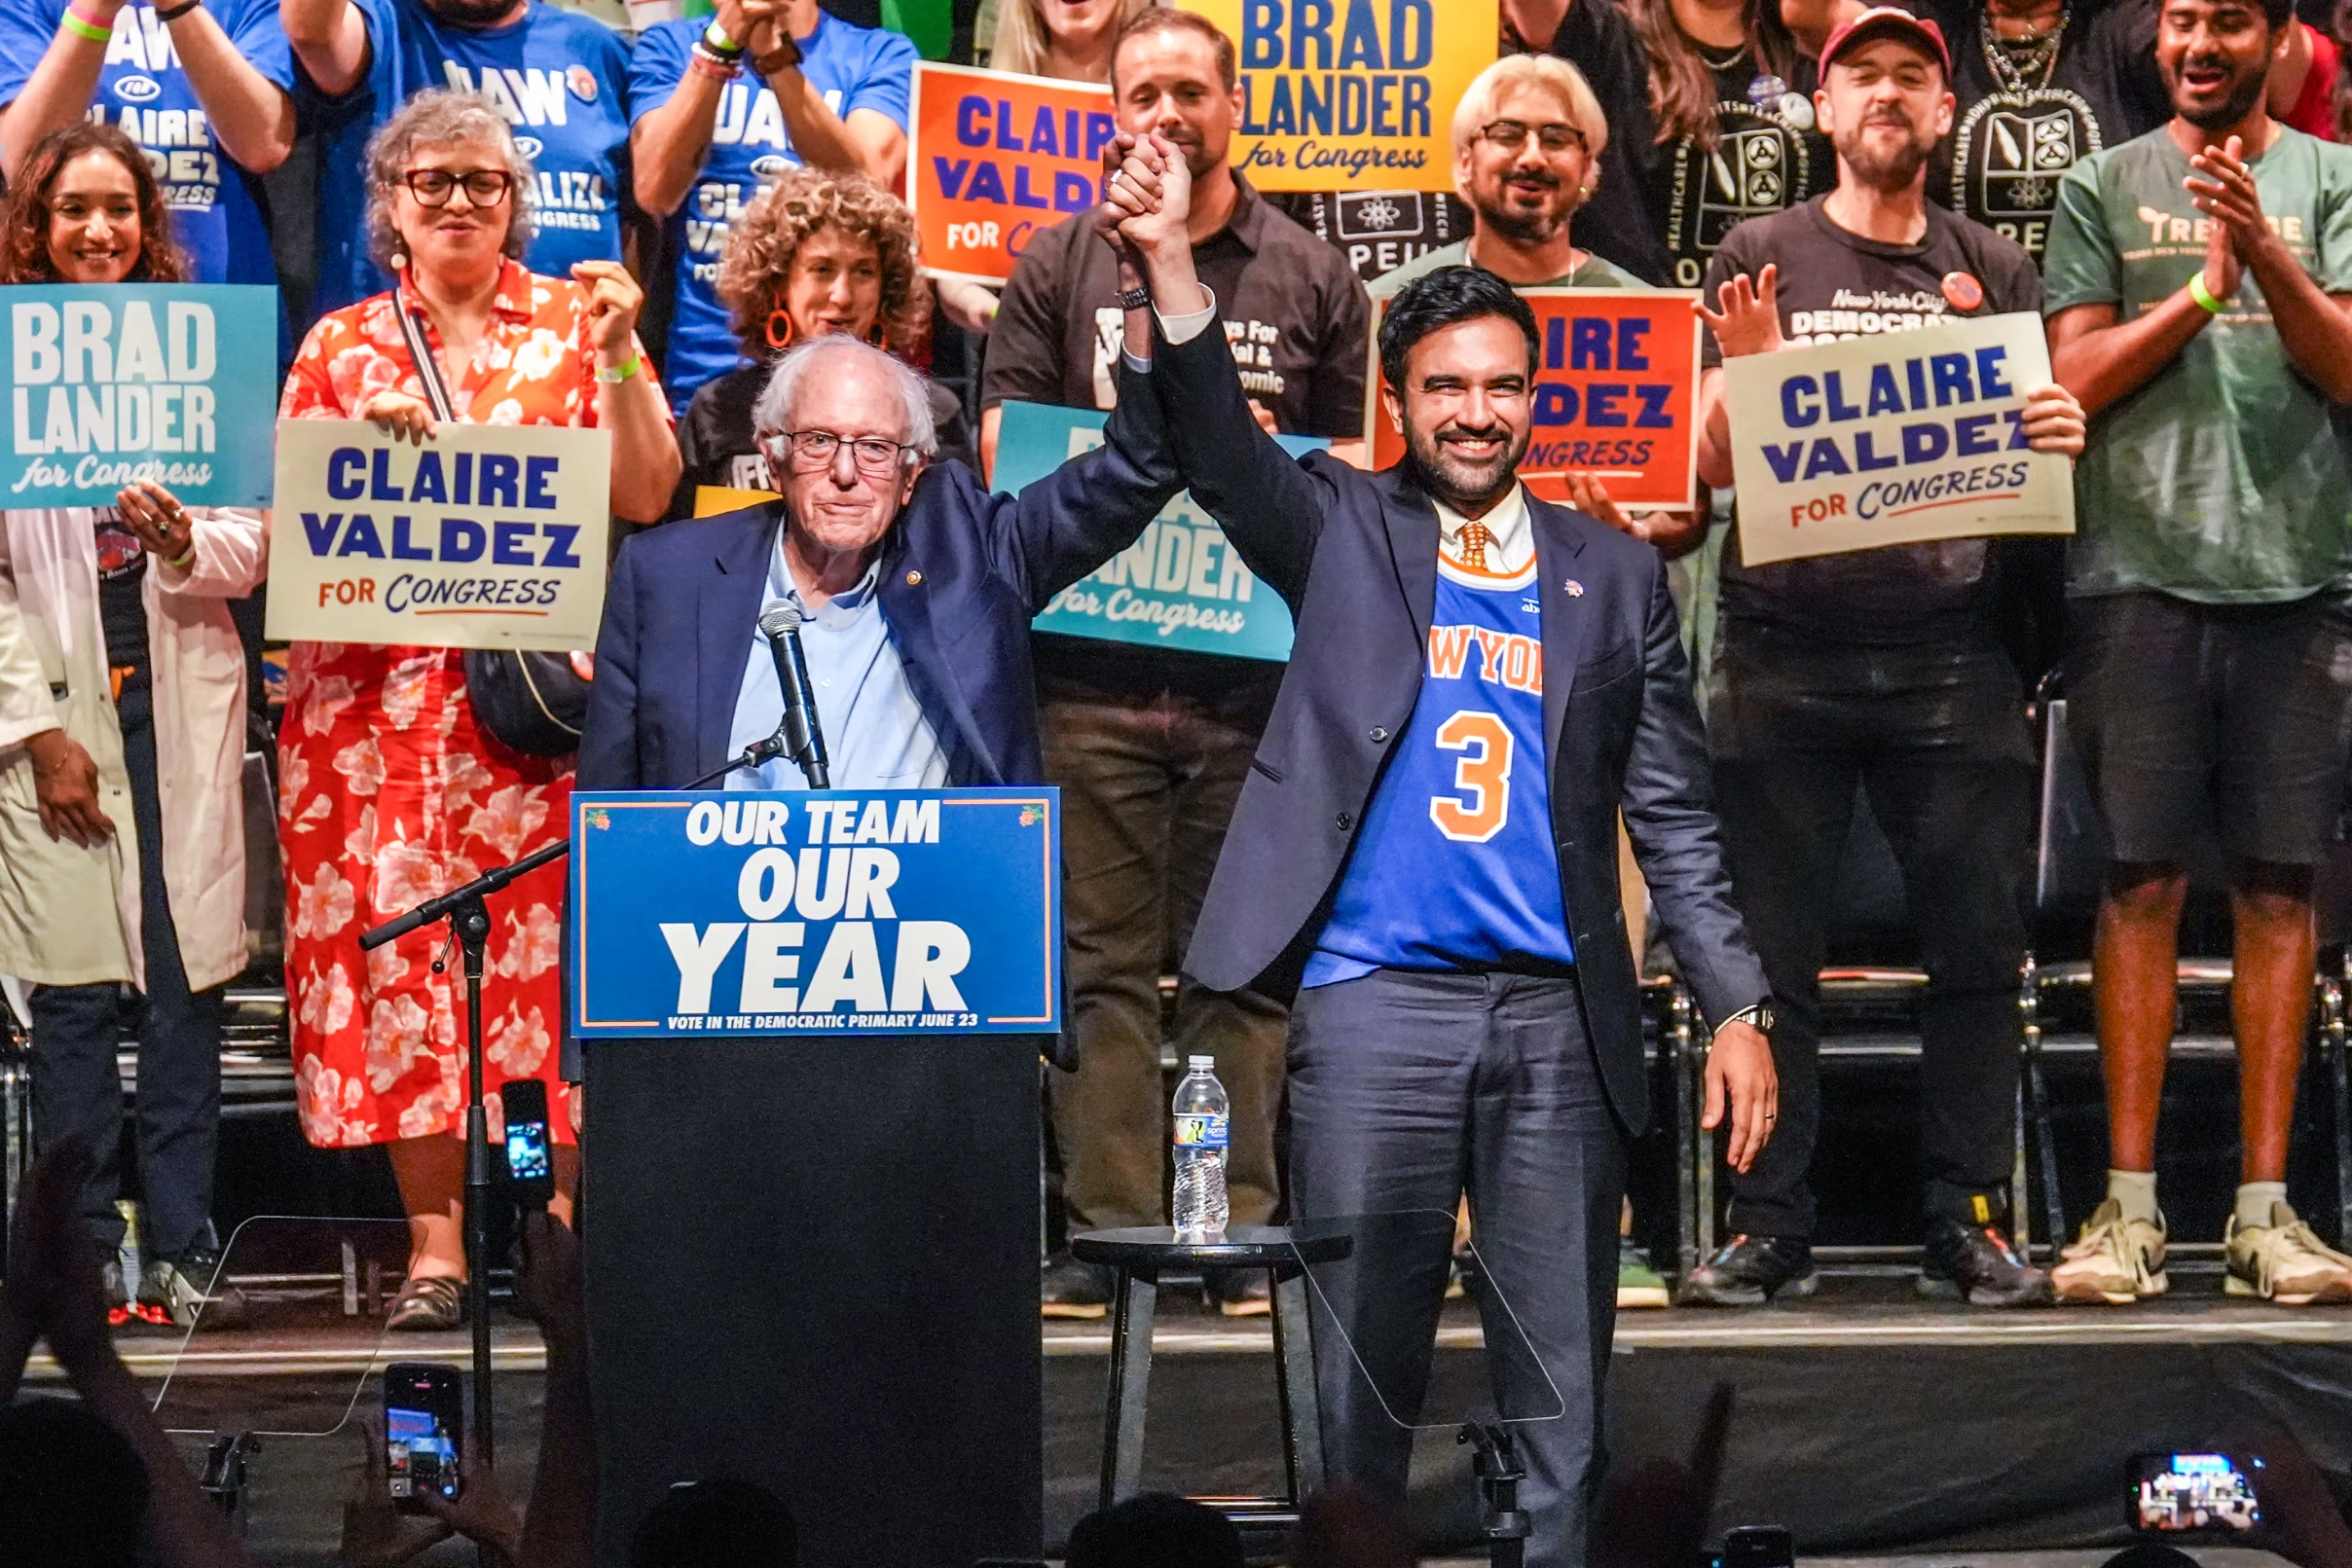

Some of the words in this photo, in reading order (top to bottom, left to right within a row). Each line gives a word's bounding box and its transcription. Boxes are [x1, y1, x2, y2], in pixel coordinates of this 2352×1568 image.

[104, 4, 182, 71] AW
[1242, 0, 1433, 69] BRAD
[957, 94, 1116, 161] CLAIR
[1240, 75, 1431, 136] LANDER
[933, 156, 1106, 213] VALD
[1231, 141, 1288, 170] for
[1296, 140, 1428, 178] Congress
[527, 210, 602, 232] NGRESS
[947, 221, 1000, 249] FOR
[1831, 289, 1874, 309] New
[1872, 290, 1912, 310] York
[1911, 291, 1949, 313] City
[12, 301, 217, 383] BRAD
[1248, 319, 1279, 344] For
[1257, 345, 1272, 367] &
[1538, 317, 1651, 372] IRE
[1532, 383, 1673, 428] DEZ
[1780, 345, 2013, 429] CLAIRE
[13, 385, 216, 456] LANDER
[1761, 409, 2032, 484] VALDEZ
[12, 456, 71, 492] for
[74, 455, 212, 490] Congress
[327, 447, 559, 509] CLAIRE
[1525, 439, 1654, 467] NGRESS
[1790, 493, 1848, 528] FOR
[301, 512, 581, 568] VALDEZ
[1082, 524, 1254, 602] NDER
[319, 577, 376, 608] FOR
[1106, 588, 1246, 637] Congress
[1429, 710, 1514, 843] 3
[685, 800, 790, 846] OUR
[805, 799, 940, 844] TEAM
[738, 847, 900, 921] OUR
[659, 921, 972, 1014] YEAR
[667, 1016, 703, 1030] VOTE
[706, 1016, 719, 1029] IN
[725, 1016, 751, 1029] THE
[754, 1015, 845, 1029] DEMOCRATIC
[848, 1014, 916, 1028] PRIMARY
[918, 1014, 955, 1027] JUNE
[958, 1013, 978, 1026] 23
